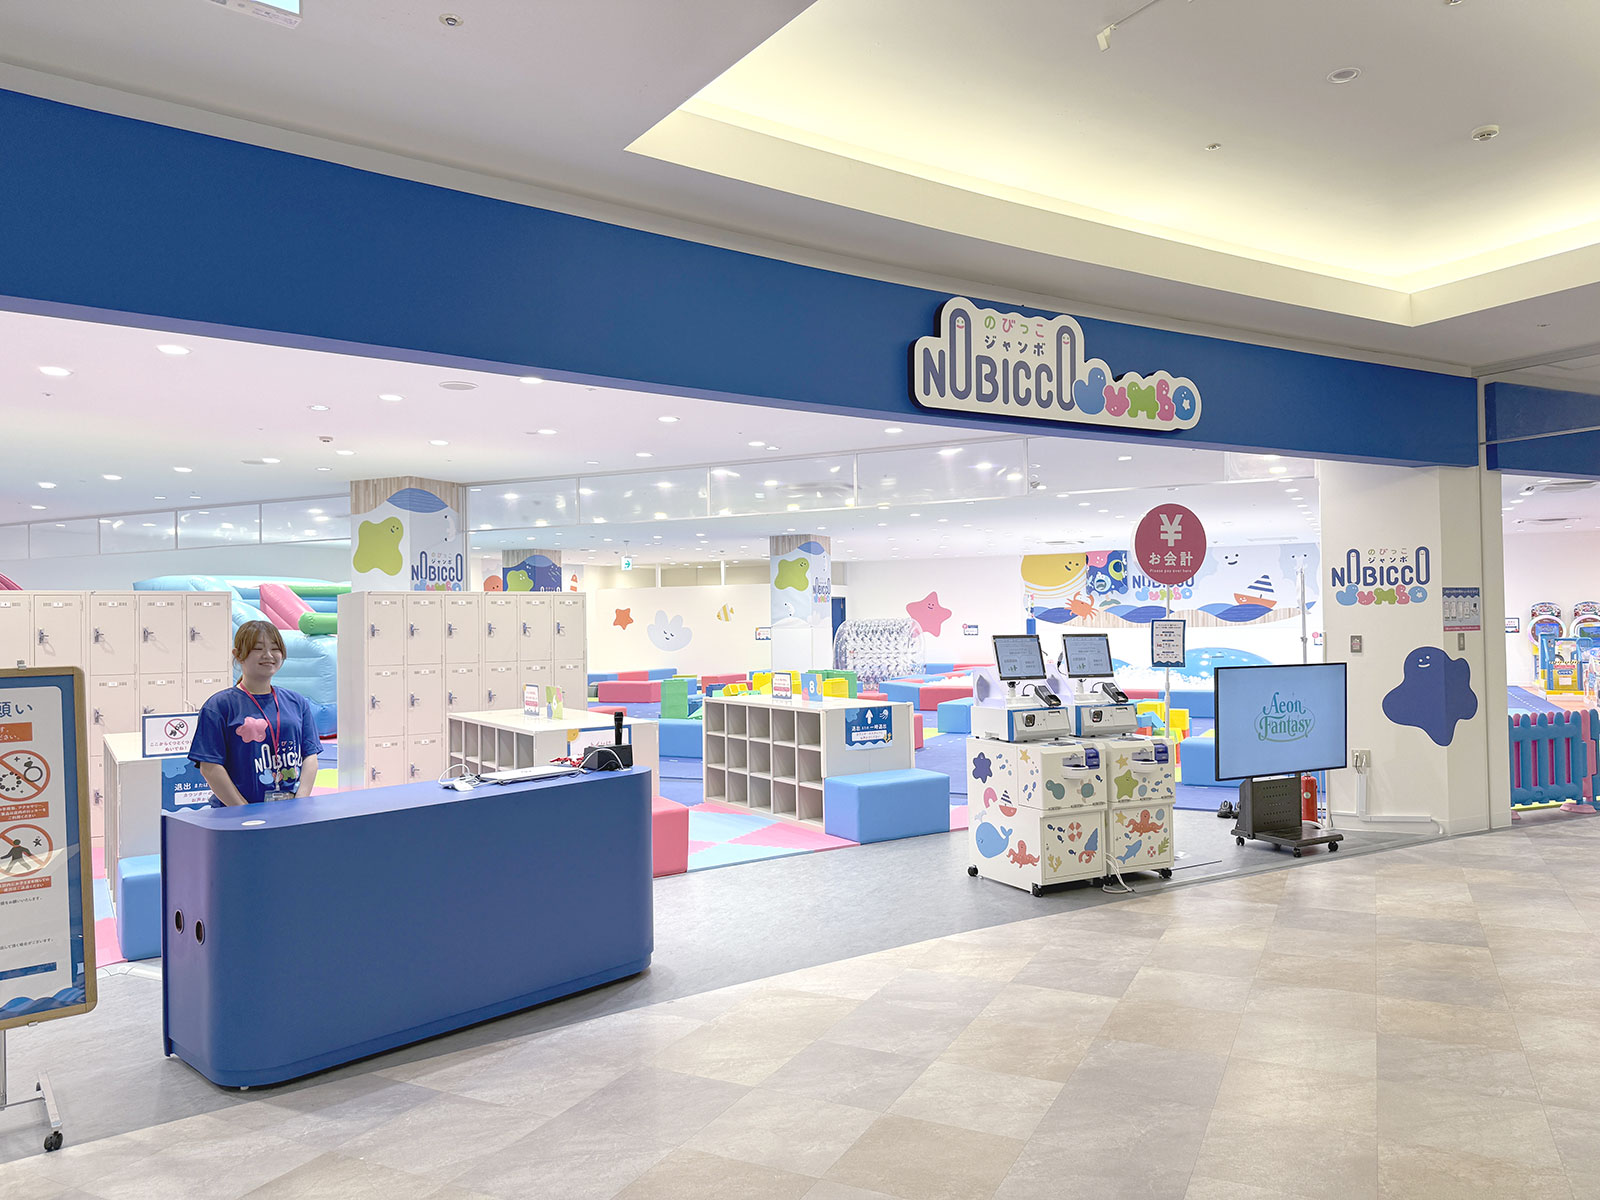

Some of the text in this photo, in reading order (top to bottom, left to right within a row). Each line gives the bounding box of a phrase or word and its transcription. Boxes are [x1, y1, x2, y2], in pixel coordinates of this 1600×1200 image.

[984, 314, 1045, 338] のびっこ
[984, 335, 1046, 357] ジャンボ
[923, 307, 1076, 411] NOBICCO
[1148, 551, 1193, 567] お会計
[1367, 547, 1408, 556] のびっこ
[1367, 556, 1408, 564] ジャンボ
[411, 551, 463, 582] NOBICCO
[1331, 546, 1430, 587] NOBICCO
[809, 680, 815, 694] 8
[1263, 692, 1306, 715] Aeon
[1258, 714, 1312, 741] Fantasy
[174, 782, 192, 791] 退出
